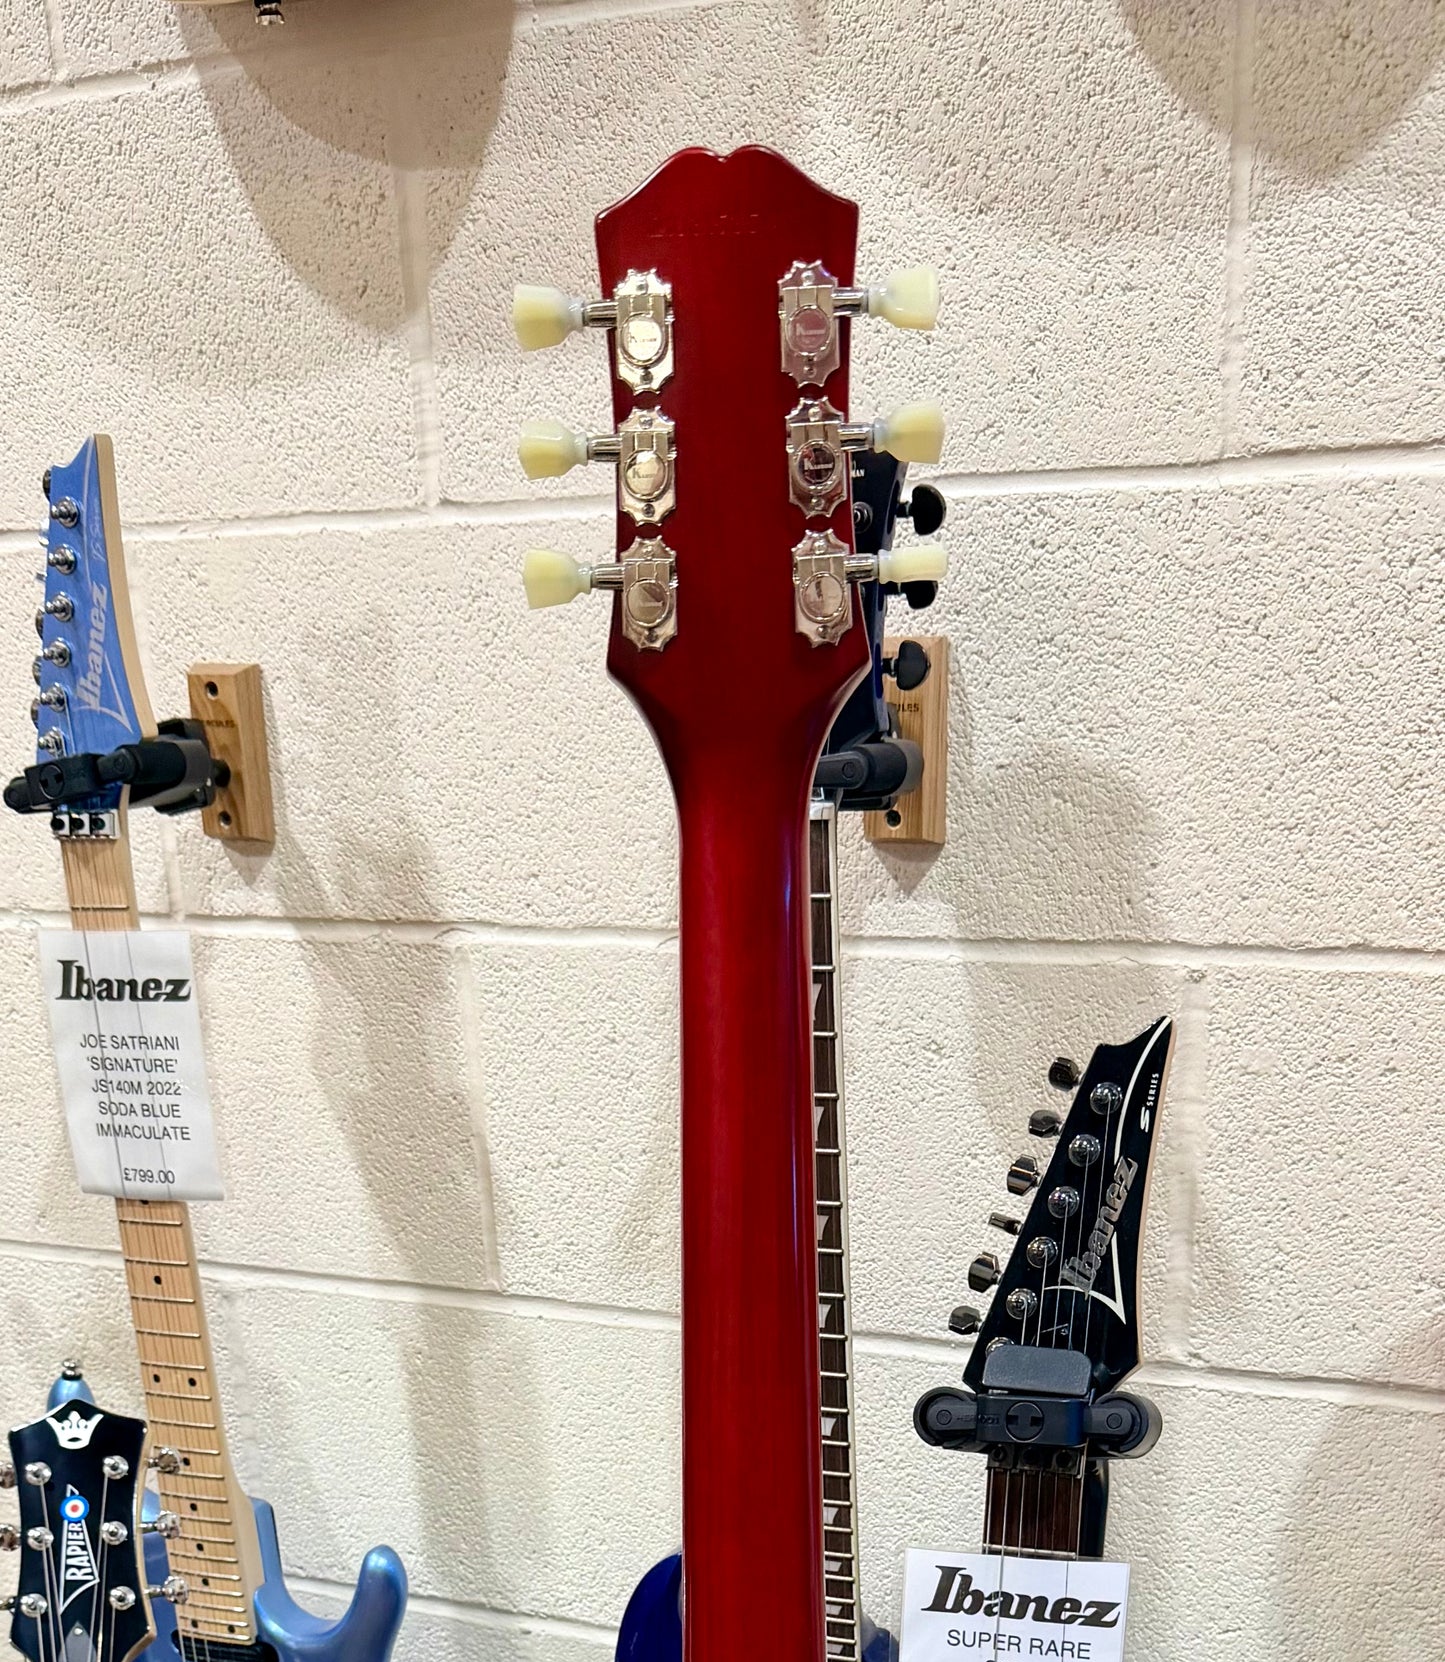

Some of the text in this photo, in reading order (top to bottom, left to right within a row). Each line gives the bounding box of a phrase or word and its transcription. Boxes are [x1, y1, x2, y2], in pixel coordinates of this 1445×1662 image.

[77, 580, 107, 712] Ibanez
[55, 959, 192, 1002] Ibanez
[80, 1034, 180, 1050] JOE SATRIANI
[92, 1080, 182, 1096] JS140M 2022
[1147, 1073, 1160, 1106] SERIES
[98, 1101, 181, 1118] SODA BLUE
[96, 1123, 191, 1141] IMMACULATE
[124, 1168, 175, 1184] £799.00
[1058, 1155, 1139, 1301] Ibanez
[65, 1522, 95, 1581] RAPIER
[920, 1565, 1122, 1628] Ibanez
[946, 1629, 1092, 1660] SUPER RARE
